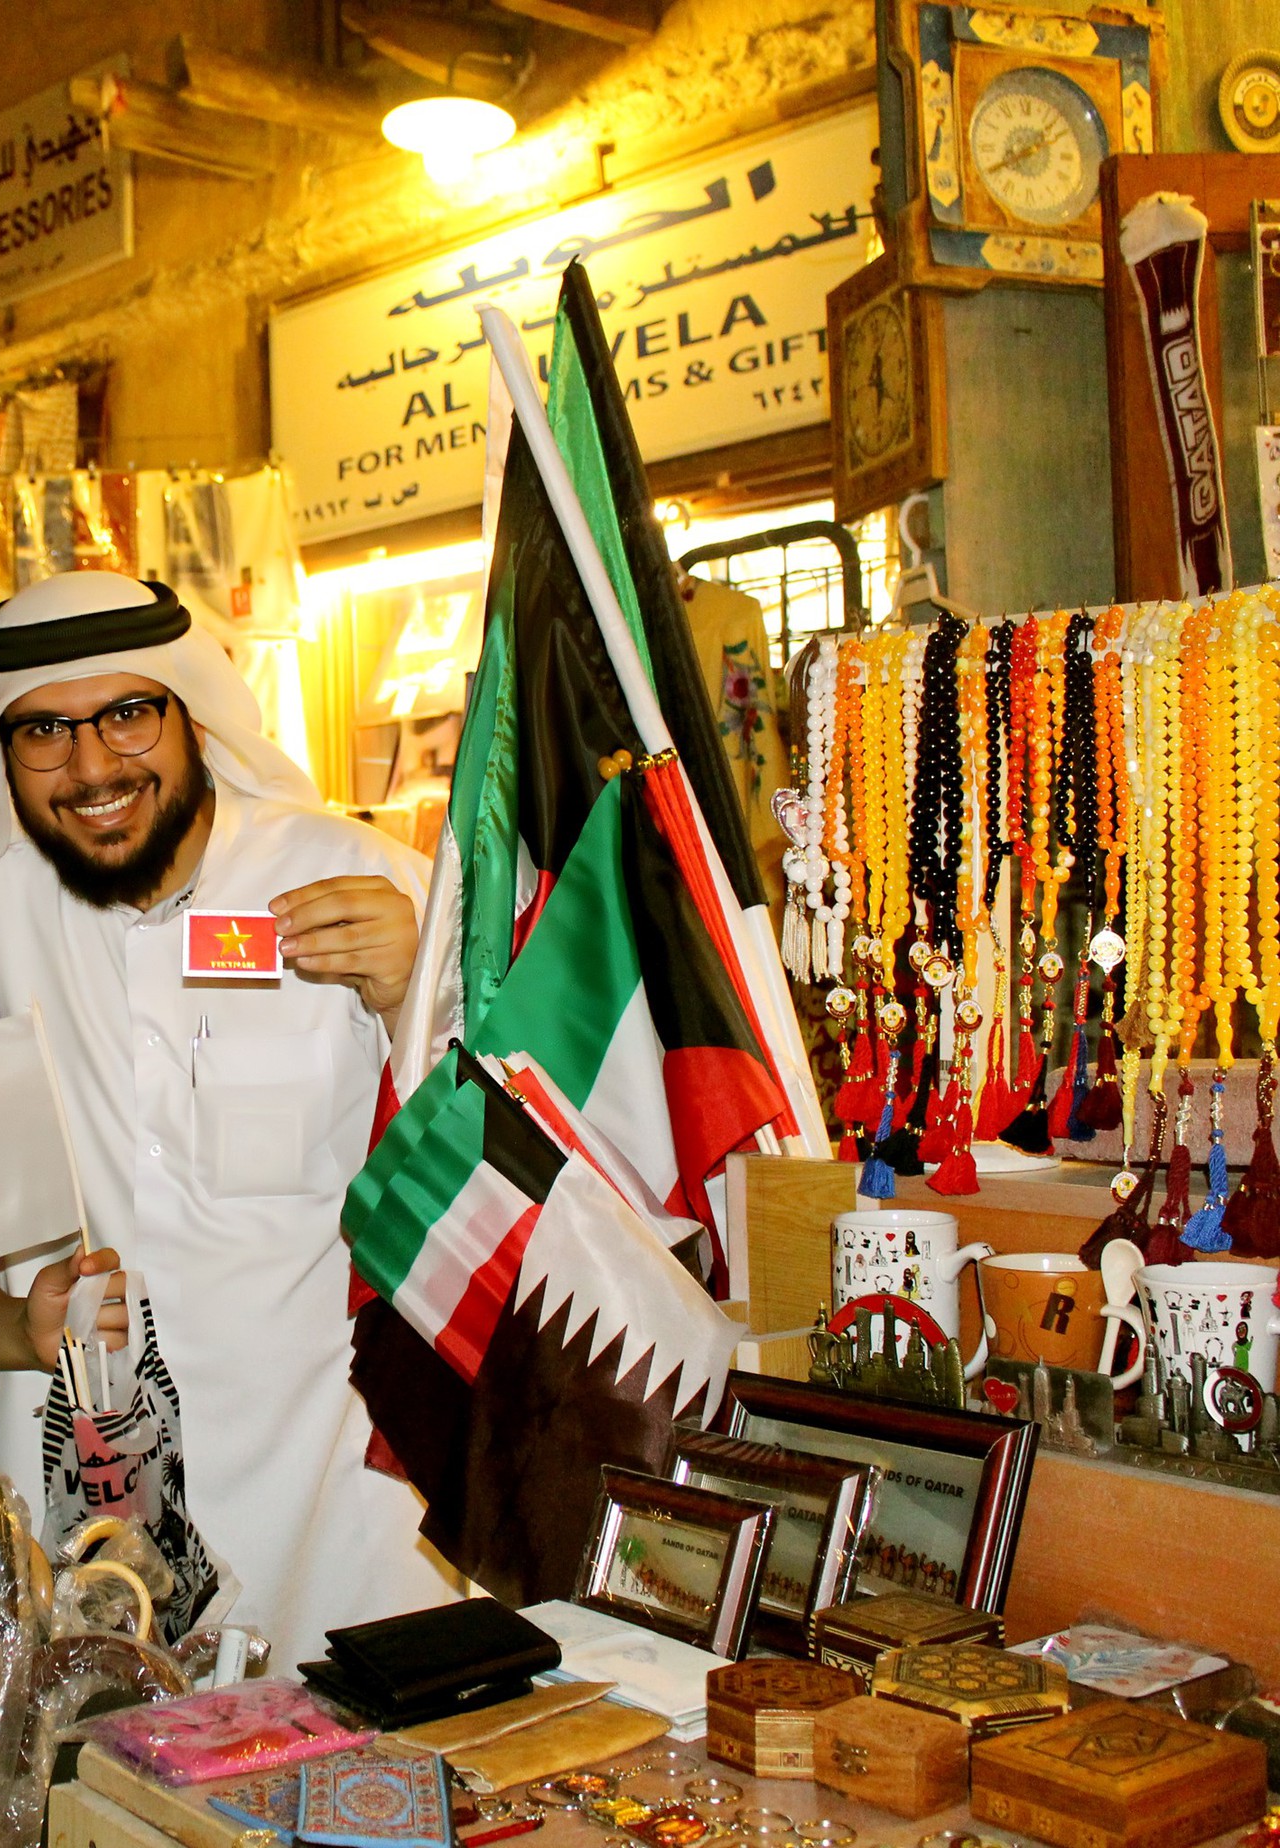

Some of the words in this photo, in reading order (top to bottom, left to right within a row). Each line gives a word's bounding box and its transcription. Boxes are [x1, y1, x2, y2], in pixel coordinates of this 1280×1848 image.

[338, 444, 404, 481] FOR
[684, 360, 715, 388] &
[729, 327, 827, 374] GIFT
[402, 382, 471, 427] AL
[1162, 333, 1218, 526] QATAR
[1039, 1292, 1076, 1336] R
[905, 1474, 922, 1487] OF
[924, 1479, 964, 1498] QATAR
[661, 1537, 685, 1551] SANDS
[696, 1547, 719, 1560] QATAR
